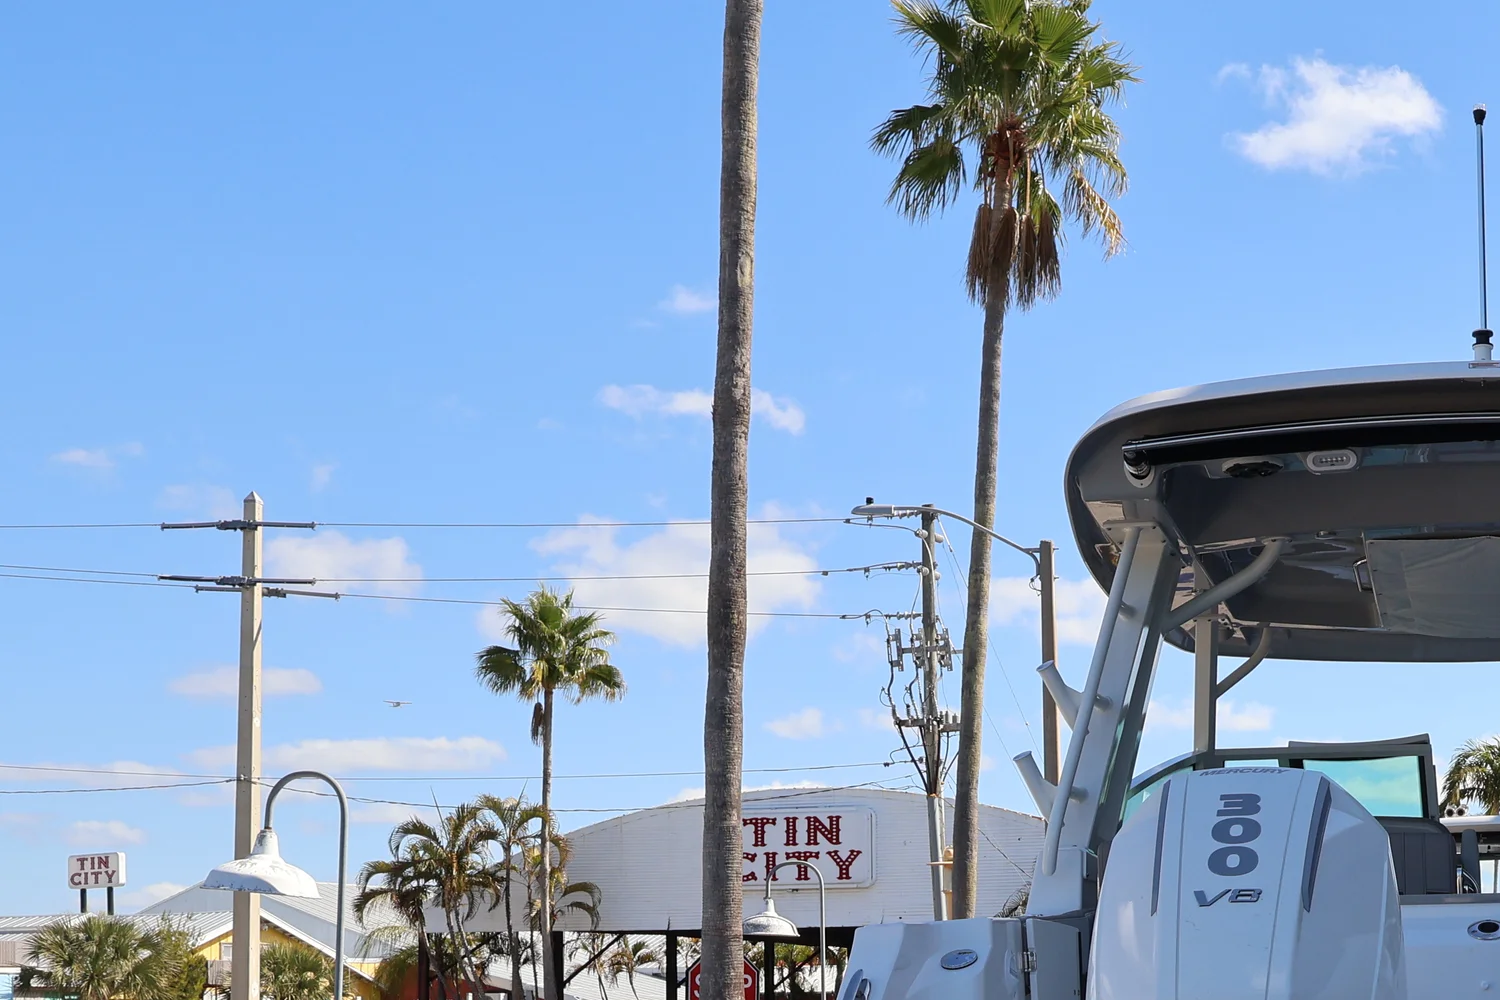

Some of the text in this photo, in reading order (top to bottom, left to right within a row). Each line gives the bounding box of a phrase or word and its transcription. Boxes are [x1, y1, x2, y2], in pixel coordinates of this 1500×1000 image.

[1199, 768, 1290, 777] MERCURY
[742, 815, 842, 847] TIN
[1207, 793, 1262, 877] 300
[76, 855, 110, 871] TIN
[70, 870, 117, 886] CITY
[1193, 888, 1263, 907] V8
